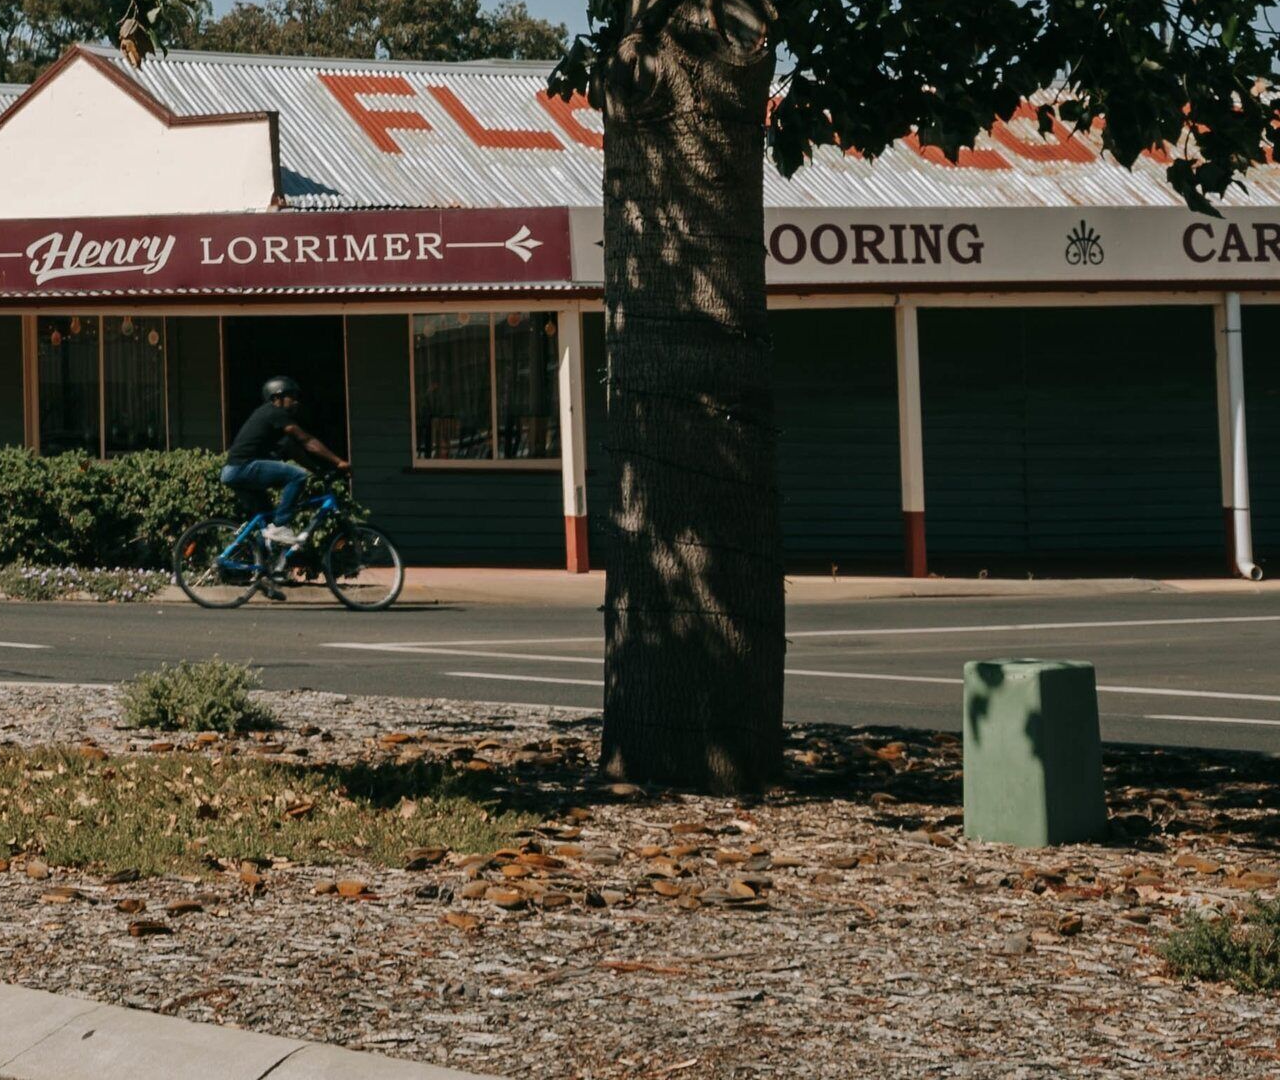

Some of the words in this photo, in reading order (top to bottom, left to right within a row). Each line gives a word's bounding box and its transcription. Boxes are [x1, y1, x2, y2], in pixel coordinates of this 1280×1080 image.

[26, 231, 176, 286] Henry
[200, 232, 444, 265] LORRIMER
[770, 223, 985, 265] OORING
